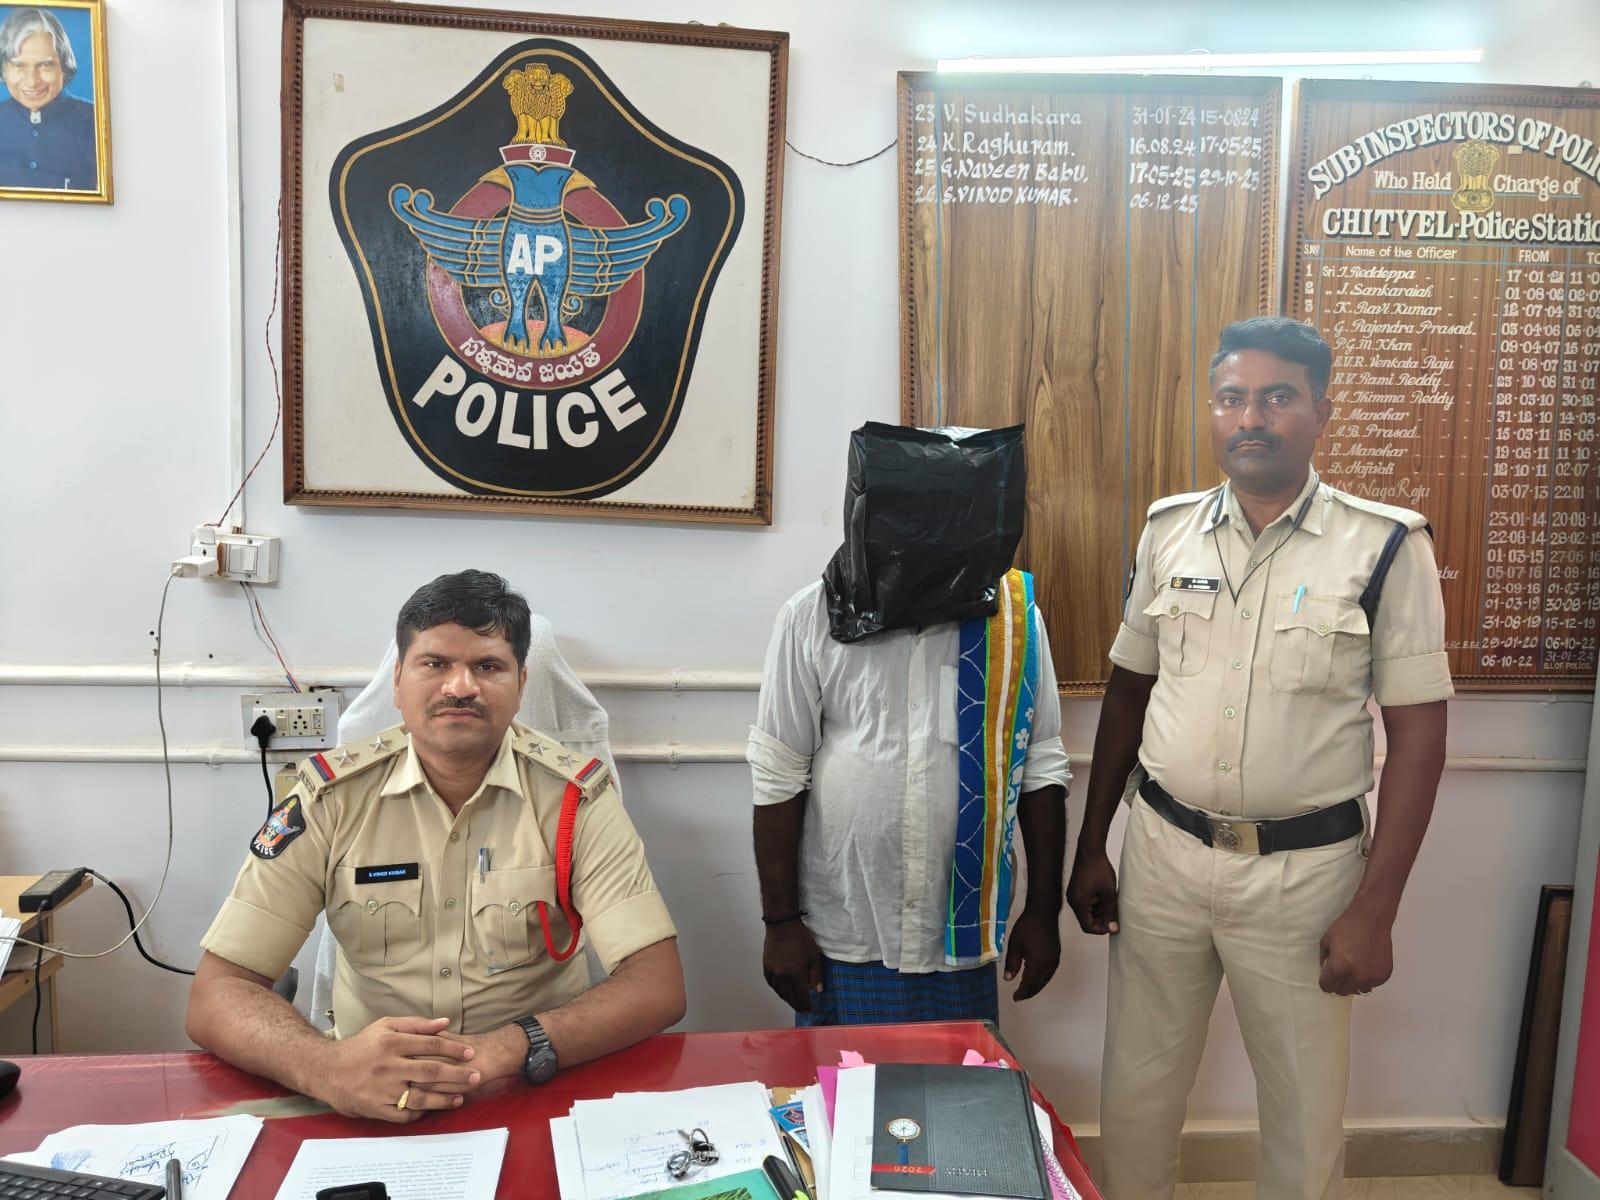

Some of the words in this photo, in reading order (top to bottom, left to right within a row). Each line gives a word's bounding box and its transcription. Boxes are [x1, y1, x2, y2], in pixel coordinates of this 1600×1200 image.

[964, 103, 1083, 125] Sudhakara
[1518, 118, 1552, 150] OF
[1374, 170, 1408, 189] Who
[1412, 171, 1452, 190] Held
[1493, 174, 1560, 202] Charge
[1563, 177, 1581, 195] of
[506, 233, 563, 276] AP
[1345, 245, 1375, 257] Name
[1379, 245, 1392, 257] of
[1394, 246, 1413, 258] the
[1416, 246, 1458, 259] Officer
[1519, 249, 1550, 263] FROM
[1305, 263, 1313, 277] 1
[1322, 265, 1335, 277] Sri
[1304, 281, 1314, 295] 2
[1304, 299, 1313, 313] 3
[1390, 303, 1442, 316] Kumar
[1350, 318, 1414, 338] Rajendra
[1375, 338, 1413, 351] Khan
[1420, 355, 1454, 375] Raju
[1395, 373, 1441, 393] Reddy
[412, 354, 647, 450] POLICE
[1409, 390, 1455, 411] Reddy
[1343, 407, 1409, 421] Manohar
[1342, 442, 1408, 457] Manohar
